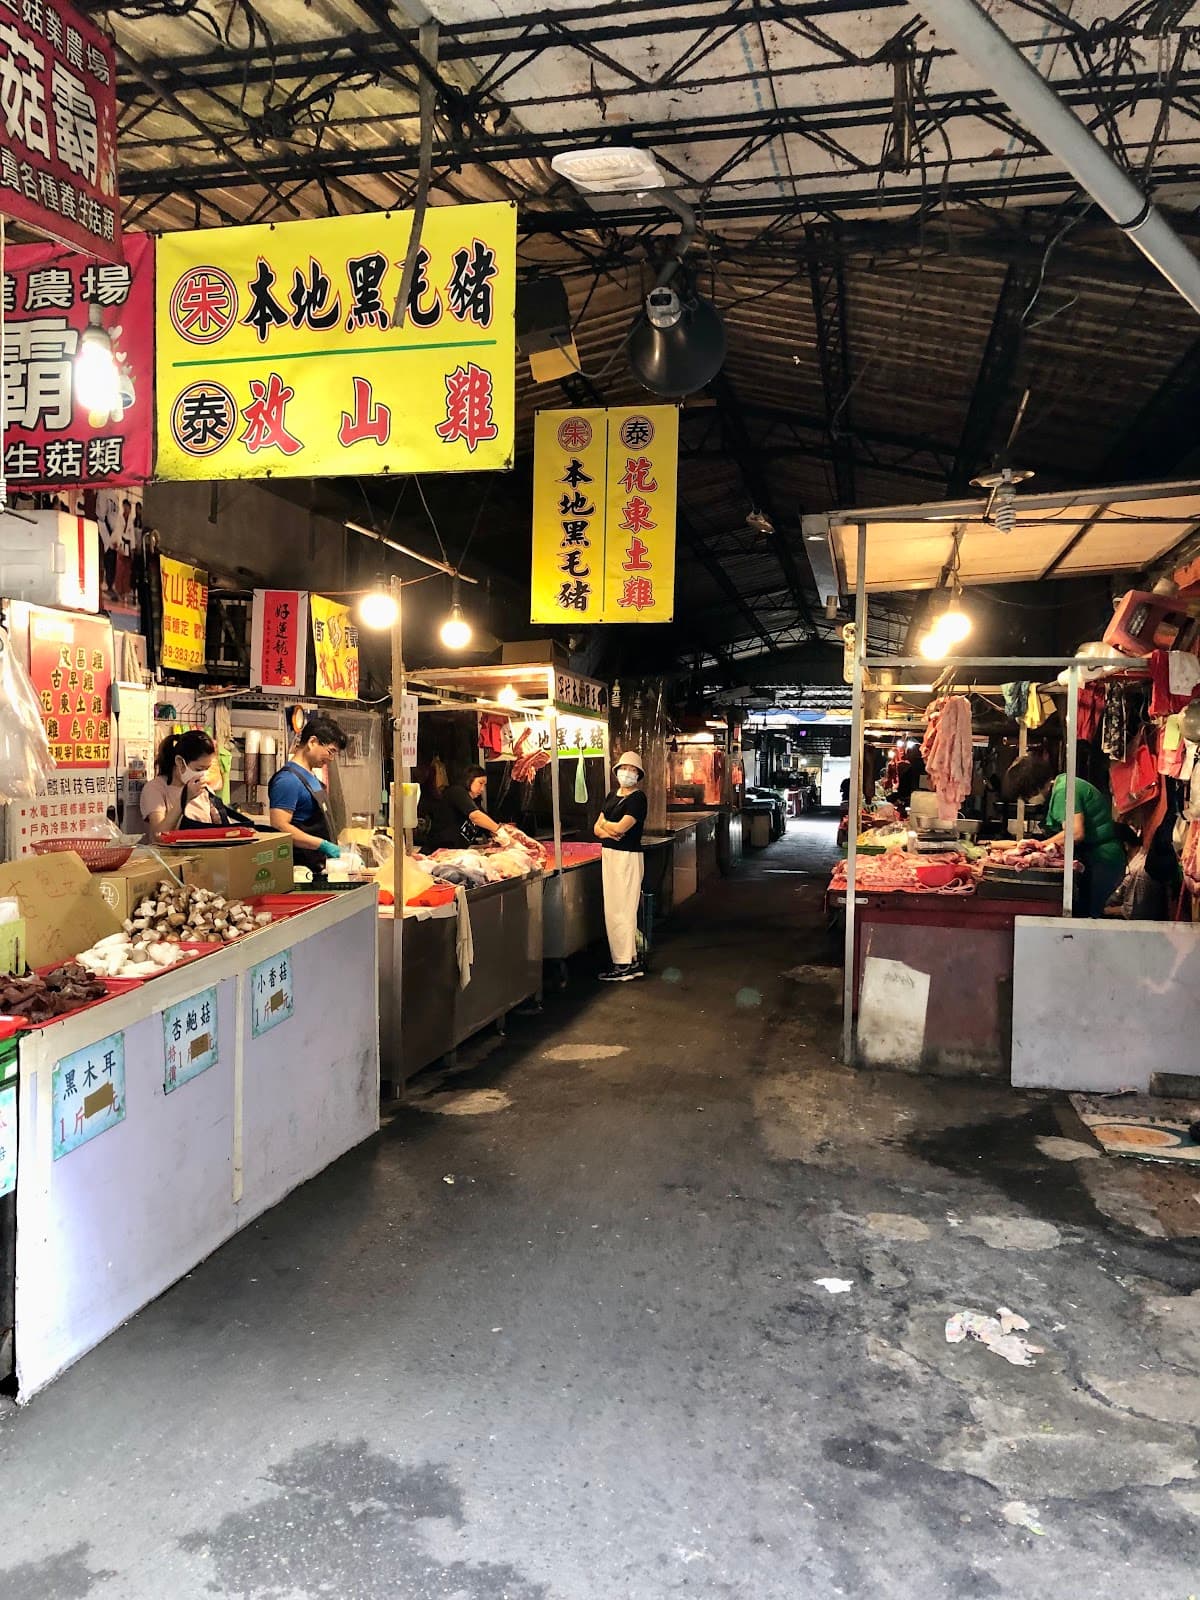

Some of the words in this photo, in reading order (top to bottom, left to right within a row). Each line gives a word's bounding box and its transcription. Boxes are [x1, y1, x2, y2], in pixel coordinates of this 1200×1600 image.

[0, 22, 98, 187] 菇霸
[3, 266, 132, 311] 農場
[176, 271, 232, 339] 朱
[240, 238, 499, 343] 本地黑毛豬
[177, 387, 232, 450] 泰
[239, 362, 497, 454] 放山雞
[3, 438, 124, 479] 生菇類
[556, 458, 594, 611] 本地黑毛豬
[618, 457, 657, 611] 花東土雞
[257, 960, 288, 994] 小香菇
[171, 1000, 211, 1042] 杏鮑菇
[63, 1049, 117, 1101] 黑木耳
